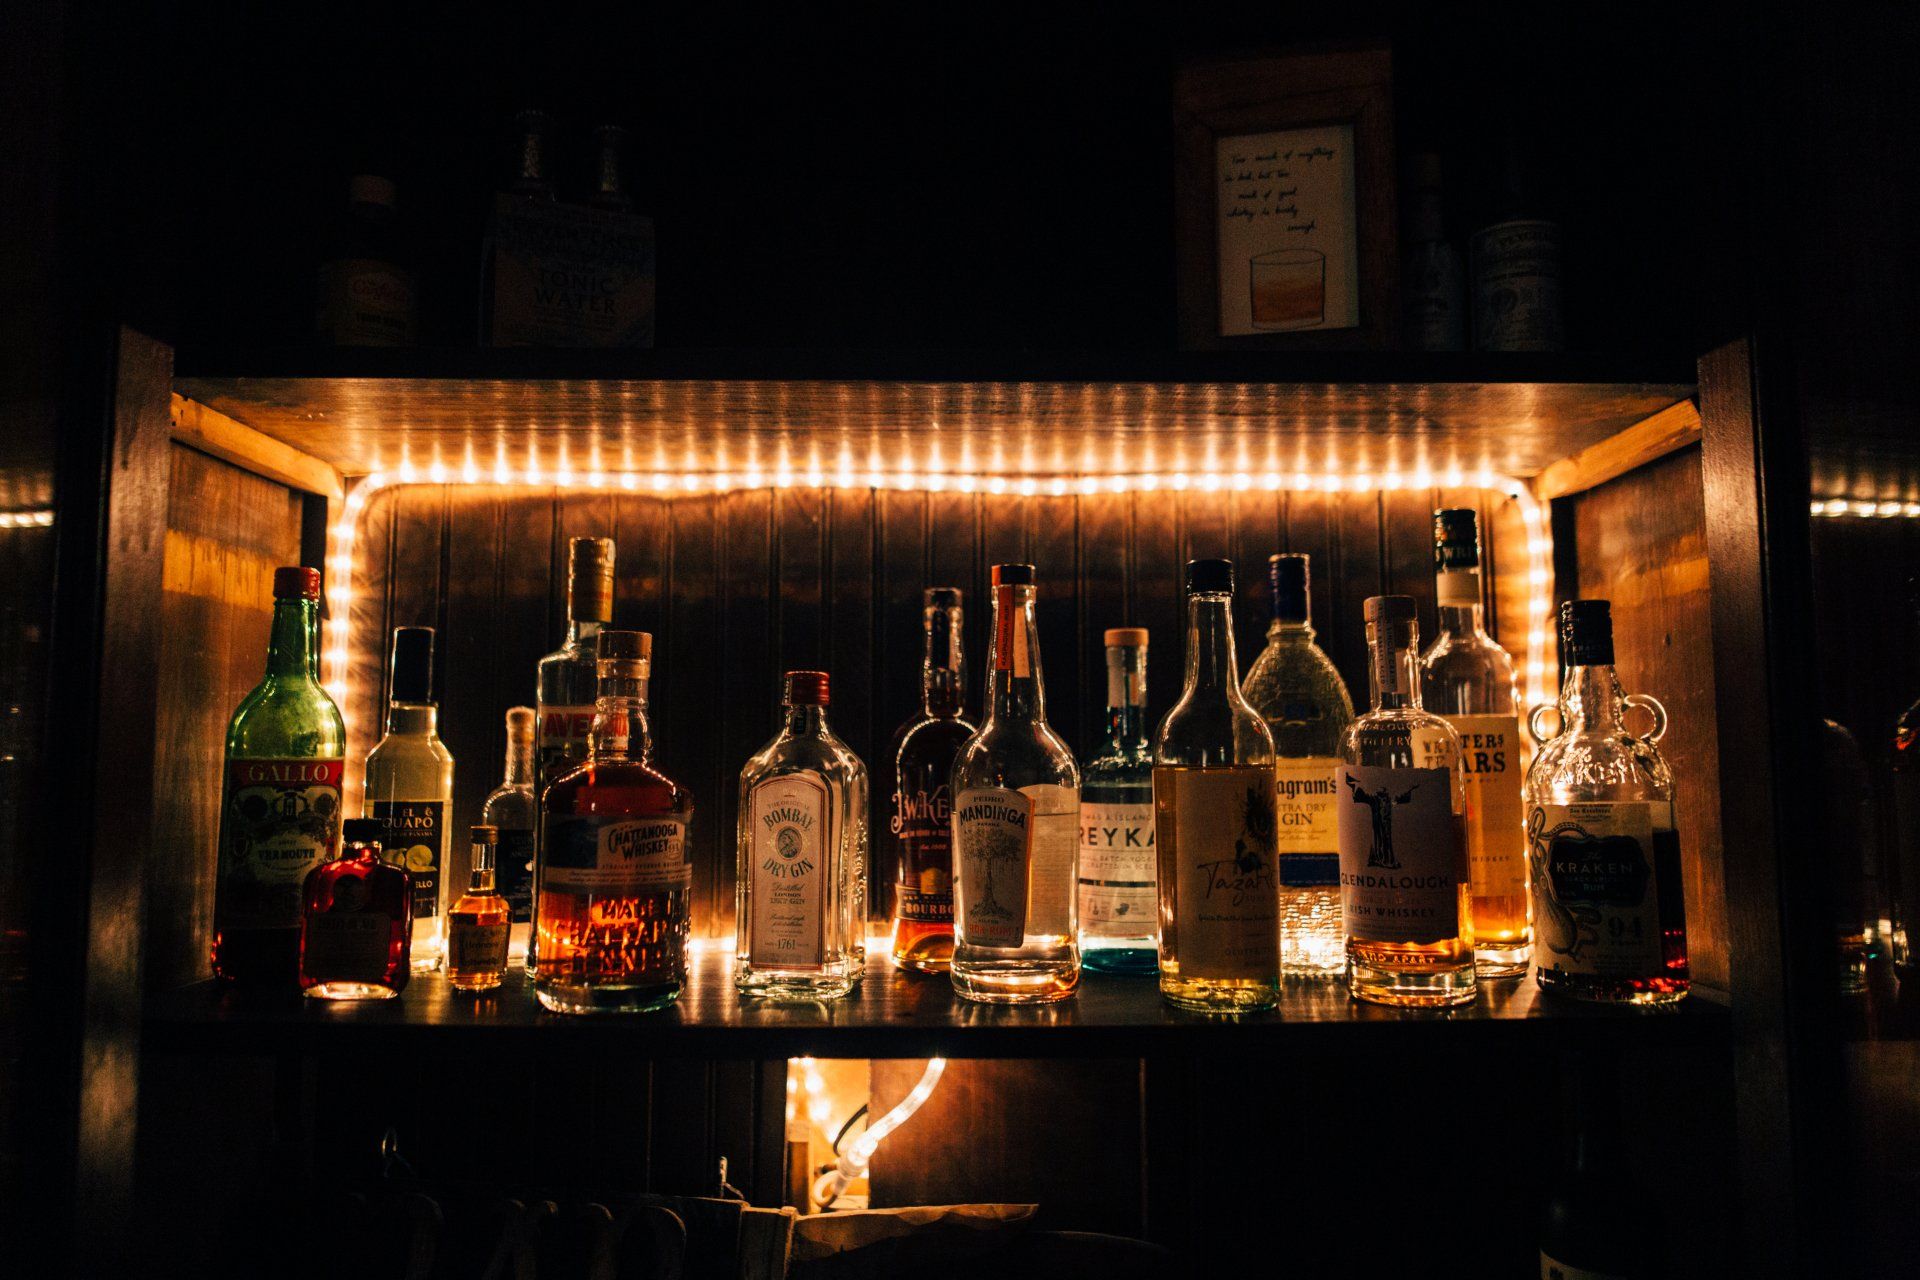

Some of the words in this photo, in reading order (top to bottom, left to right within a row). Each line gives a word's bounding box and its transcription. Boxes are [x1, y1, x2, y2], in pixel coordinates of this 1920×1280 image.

[536, 267, 617, 296] TONIC
[531, 285, 618, 316] WATER
[247, 763, 328, 783] GALLO
[1275, 776, 1337, 801] agram's
[959, 804, 1027, 830] MANDINGA
[1305, 802, 1328, 813] DRY
[762, 807, 816, 833] BOMBAY
[1281, 812, 1314, 826] GIN
[607, 823, 679, 854] CHATTANOOGA
[621, 838, 670, 862] WHISKEY
[762, 857, 789, 879] DRY
[789, 857, 815, 878] GIN
[1555, 861, 1634, 875] KRAKEN
[1340, 871, 1448, 890] GLENDALOUGH
[903, 901, 954, 916] BOURBO
[1375, 906, 1436, 918] WHISKEY
